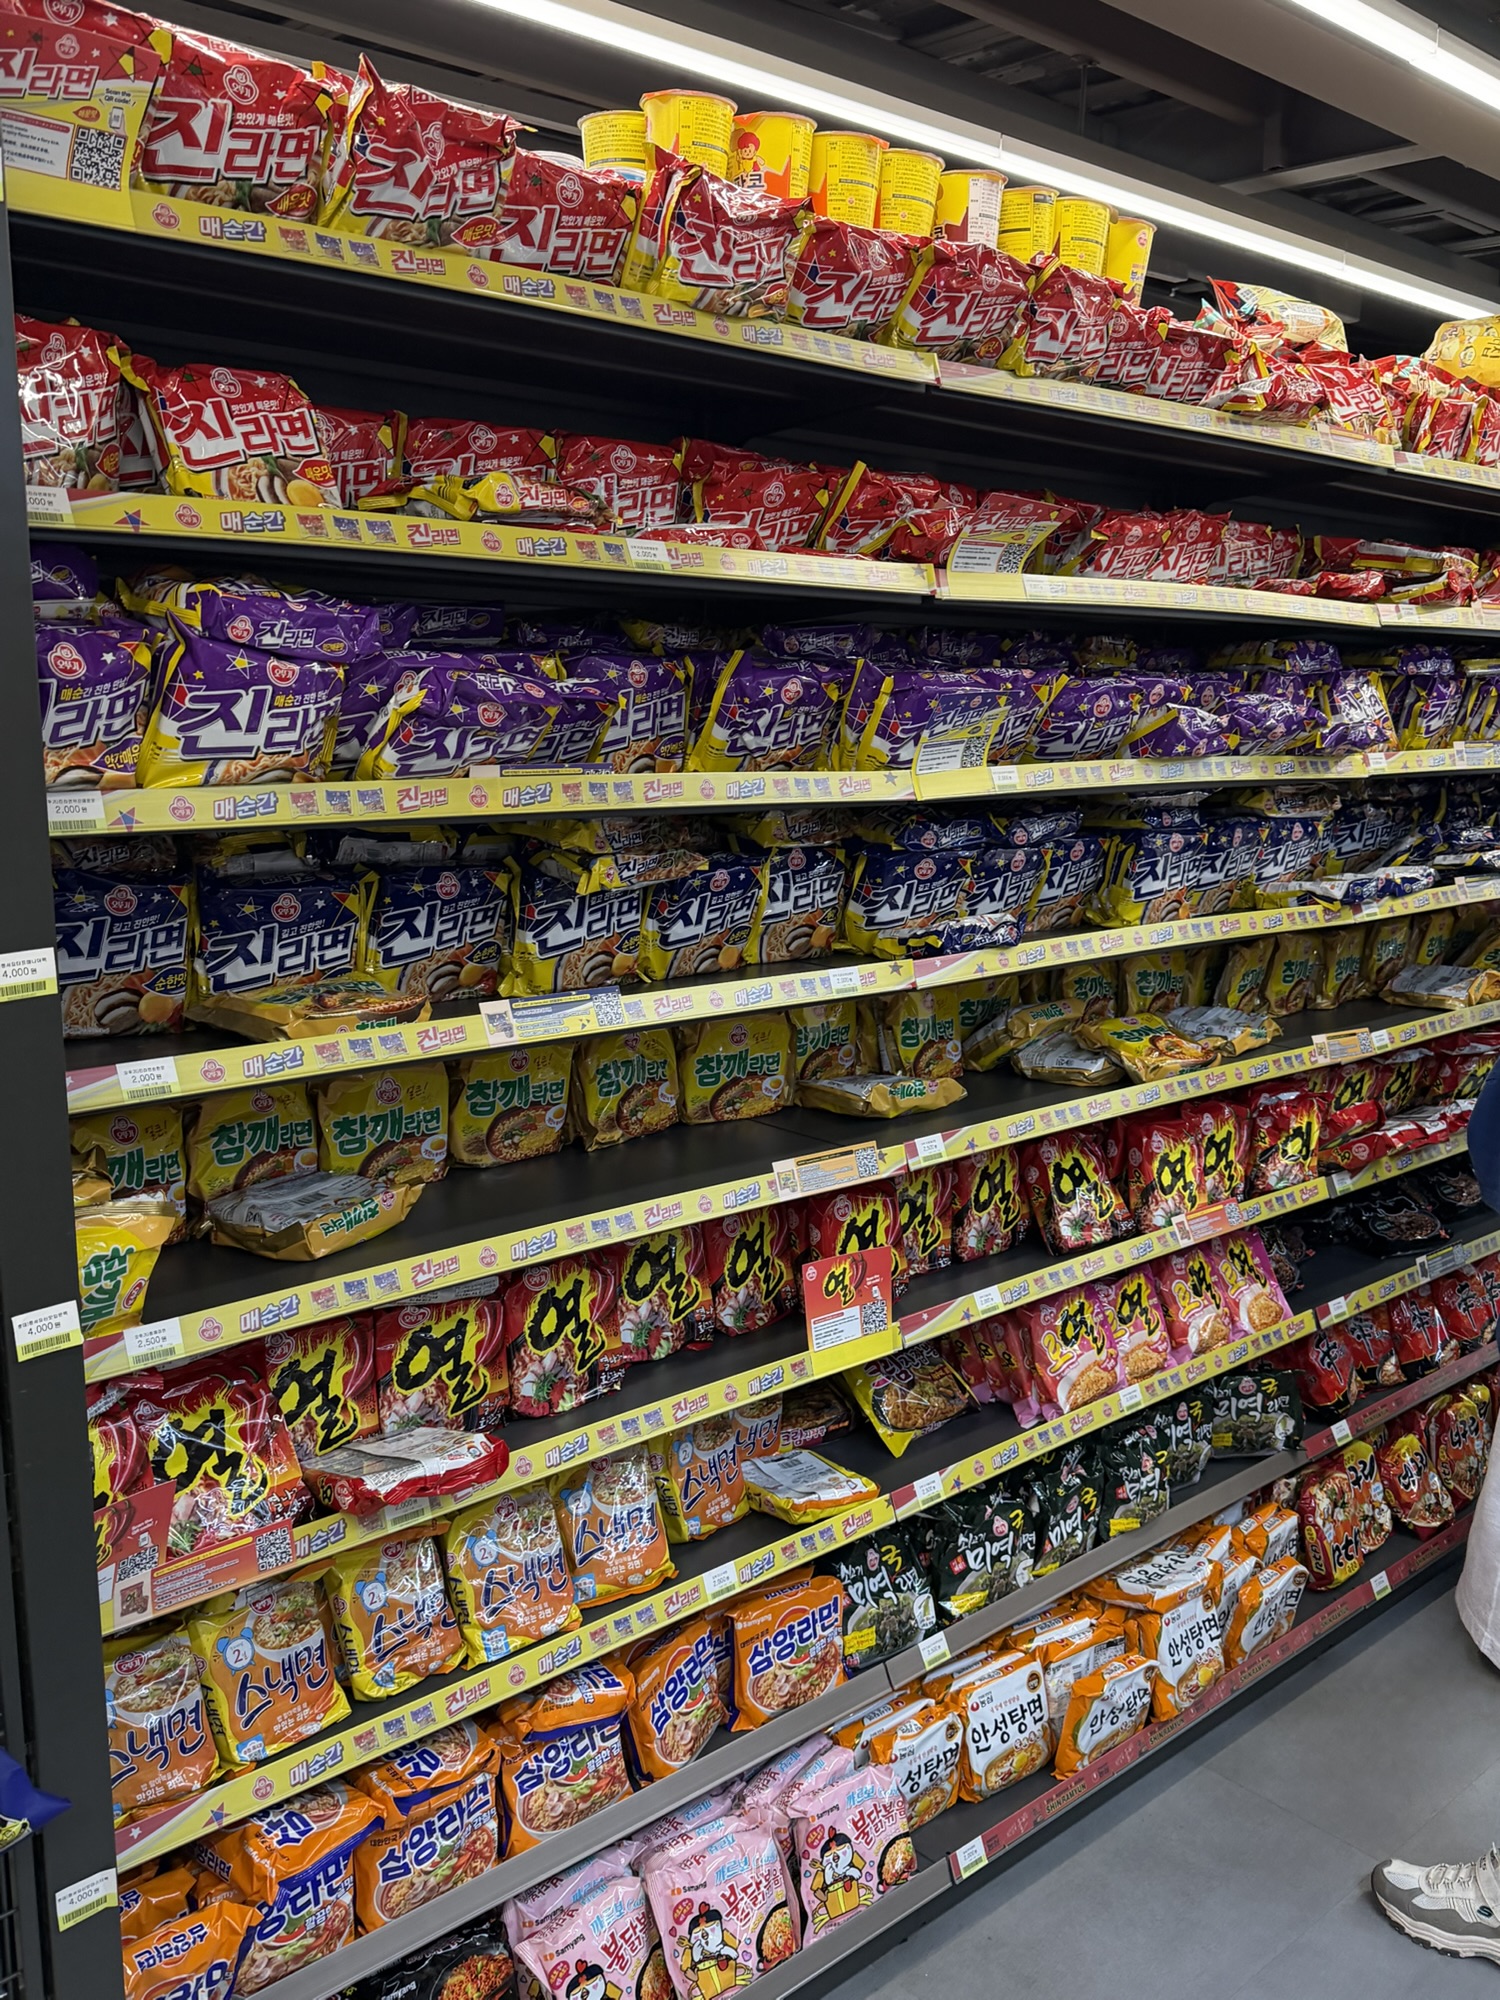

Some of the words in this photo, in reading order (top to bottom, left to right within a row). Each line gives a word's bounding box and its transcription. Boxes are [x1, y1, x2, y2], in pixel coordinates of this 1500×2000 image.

[105, 88, 120, 96] Scan
[122, 90, 131, 98] the
[236, 112, 262, 127] 맛있게
[141, 96, 322, 184] 진라면
[351, 142, 500, 221] 진라면
[273, 190, 312, 216] 매운맛
[198, 216, 266, 242] 매순간
[461, 222, 497, 242] 매운맛
[500, 204, 629, 276] 진라면
[391, 249, 446, 275] 진라면
[676, 218, 791, 289] 진라면
[503, 277, 555, 298] 매순간
[653, 304, 696, 327] 진라면
[741, 326, 784, 345] 매순간
[231, 401, 254, 413] 맛있게
[256, 400, 280, 413] 매운맛!
[164, 398, 322, 472] 진라면
[305, 464, 332, 480] 매운맛
[519, 485, 567, 508] 진라면
[220, 510, 286, 533] 매순간
[407, 522, 461, 547] 진라면
[965, 509, 1038, 537] 진라면
[515, 537, 567, 556] 매순간
[254, 620, 316, 648] 진라면
[725, 704, 834, 758] 진라면
[926, 705, 988, 739] 진라면
[642, 779, 685, 802] 진라면
[726, 778, 765, 799] 매순간
[838, 777, 871, 797] 진라면
[1024, 768, 1054, 786] 매순간
[54, 804, 88, 814] 2,000원
[213, 792, 279, 821] 매순간
[396, 786, 448, 814] 진라면
[502, 782, 553, 809] 매순간
[618, 856, 658, 881] 진라면
[1132, 853, 1201, 902] 진라면
[457, 898, 481, 910] 진한맛!
[863, 879, 967, 931] 진라면
[133, 915, 160, 929] 진한맛!
[299, 919, 326, 934] 진한맛!
[378, 899, 503, 967] 진라면
[531, 896, 641, 959] 진라면
[655, 889, 760, 951] 진라면
[726, 926, 750, 945] 순한맛
[55, 916, 188, 986] 진라면
[207, 921, 357, 994] 진라면
[472, 945, 498, 962] 순한맛
[1017, 947, 1045, 967] 매순간
[2, 966, 38, 979] 4,000원
[155, 972, 187, 990] 순한맛
[653, 993, 694, 1017] 진라면
[734, 982, 772, 1007] 매순간
[416, 1025, 466, 1052] 진라면
[797, 1018, 851, 1049] 참깨라면
[901, 1014, 954, 1049] 참깨라면
[243, 1046, 305, 1078] 매순간
[595, 1053, 669, 1097] 참깨라면
[694, 1045, 782, 1088] 참깨라면
[131, 1072, 162, 1083] 2,000원
[465, 1075, 566, 1117] 참깨라면
[211, 1115, 313, 1166] 참깨라면
[332, 1105, 443, 1158] 참깨라면
[1007, 1116, 1035, 1139] 매순간
[723, 1181, 761, 1209] 매순간
[643, 1201, 683, 1228] 진라면
[511, 1230, 557, 1261] 매순간
[411, 1255, 461, 1284] 진라면
[725, 1222, 785, 1298] 열
[624, 1232, 699, 1321] 열
[1002, 1280, 1031, 1305] 매순간
[26, 1320, 62, 1336] 4,000원
[240, 1297, 301, 1333] 매순간
[526, 1277, 605, 1373] 열
[1402, 1300, 1433, 1349] 辛
[136, 1335, 168, 1348] 2,500원
[1346, 1315, 1375, 1362] 辛
[394, 1316, 492, 1416] 열
[1316, 1332, 1345, 1385] 辛
[747, 1368, 784, 1395] 매순간
[1261, 1378, 1278, 1396] 국
[672, 1393, 710, 1422] 진라면
[1267, 1394, 1290, 1412] 라면
[1071, 1414, 1094, 1433] 진라면
[1448, 1415, 1479, 1450] 너구리
[545, 1433, 589, 1469] 매순간
[992, 1444, 1019, 1468] 매순간
[680, 1445, 740, 1512] 스낵면
[575, 1500, 659, 1566] 스낵면
[1010, 1509, 1025, 1530] 국
[1051, 1508, 1083, 1547] 미역
[295, 1520, 347, 1557] 매순간
[957, 1532, 986, 1550] 쇠고기
[966, 1529, 1015, 1573] 미역
[627, 1558, 644, 1571] 라면!
[739, 1553, 775, 1584] 매순간
[881, 1544, 903, 1572] 국
[482, 1552, 567, 1617] 스낵면
[848, 1570, 898, 1608] 미역
[899, 1570, 921, 1591] 라면
[538, 1607, 555, 1623] 라면!
[663, 1584, 701, 1619] 진라면
[372, 1595, 458, 1664] 스낵면
[747, 1597, 841, 1678] 삼양라면
[1168, 1613, 1223, 1667] 안성탕면
[430, 1645, 446, 1659] 라면!
[538, 1635, 583, 1675] 매순간
[236, 1636, 326, 1731] 스낵면
[649, 1627, 715, 1735] 삼양라면
[445, 1678, 492, 1717] 진라면
[980, 1698, 994, 1710] 농심
[1090, 1686, 1151, 1736] 안성탕면
[971, 1693, 1045, 1754] 안성탕면
[1164, 1717, 1185, 1737] RAMYUN
[109, 1696, 205, 1788] 스낵면
[289, 1742, 344, 1787] 매순간
[167, 1775, 187, 1791] 라면!
[846, 1783, 876, 1809] 까르보
[816, 1804, 840, 1820] Samyang
[1045, 1796, 1065, 1814] SHIN
[1064, 1782, 1086, 1804] RAMYUN
[377, 1781, 490, 1886] 삼양라면
[715, 1857, 750, 1885] 까르보
[69, 1887, 100, 1907] 4,000원
[535, 1906, 564, 1926] Samyang
[590, 1901, 624, 1933] 까르보
[555, 1933, 586, 1957] Samyang
